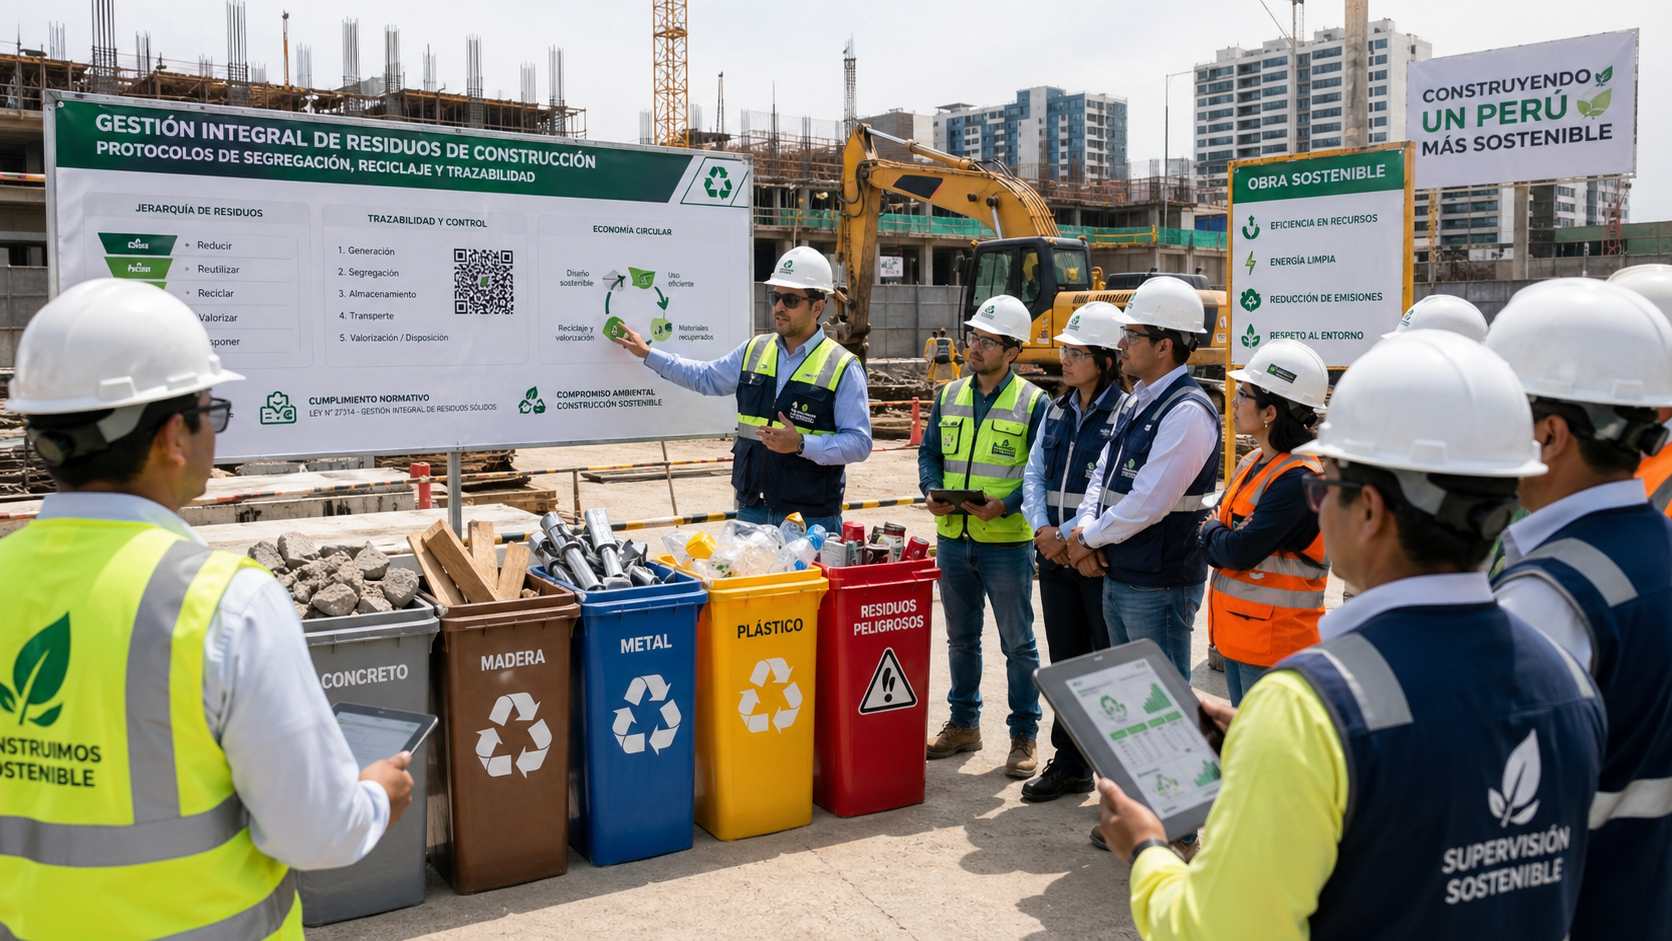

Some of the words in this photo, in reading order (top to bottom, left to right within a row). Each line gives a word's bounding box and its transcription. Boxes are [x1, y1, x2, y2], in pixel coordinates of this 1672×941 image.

[1422, 69, 1591, 103] CONSTRUYENDO
[1422, 107, 1466, 133] UN
[1476, 89, 1567, 127] PERÚ
[95, 113, 195, 138] GESTIÓN
[201, 121, 308, 147] INTEGRAL
[313, 131, 341, 149] DE
[346, 134, 441, 157] RESIDUOS
[446, 143, 469, 160] DE
[473, 145, 596, 169] CONSTRUCCIÓN
[1422, 135, 1467, 156] MÁS
[1473, 123, 1612, 151] SOSTENIBLE
[96, 140, 213, 161] PROTOCOLOS
[218, 149, 240, 163] DE
[243, 151, 355, 172] SEGREGACIÓN,
[358, 159, 432, 177] RECICLAJE
[435, 164, 444, 177] Y
[447, 166, 535, 183] TRAZABILIDAD
[1248, 174, 1288, 190] OBRA
[1291, 164, 1386, 186] SOSTENIBLE
[135, 203, 195, 215] JERARQUÍA
[197, 206, 211, 215] DE
[214, 207, 263, 217] RESIDUOS
[367, 214, 436, 226] TRAZABILIDAD
[437, 217, 444, 226] Y
[445, 218, 488, 228] CONTROL
[1270, 218, 1315, 230] EFICIENCIA
[1317, 218, 1328, 226] EN
[1330, 214, 1378, 225] RECURSOS
[593, 224, 634, 234] ECONOMÍA
[635, 227, 672, 236] CIRCULAR
[197, 241, 232, 251] Reducir
[338, 246, 345, 254] 1.
[348, 246, 395, 256] Generación
[1270, 255, 1305, 266] ENERGÍA
[1307, 255, 1336, 265] LIMPIA
[198, 264, 240, 274] Reutilizar
[338, 267, 346, 276] 2.
[348, 267, 399, 279] Segregación
[198, 289, 234, 298] Reciclar
[339, 290, 346, 298] 3.
[349, 289, 417, 299] Almacenamiento
[1270, 292, 1318, 304] REDUCCIÓN
[1320, 294, 1332, 303] DE
[1334, 292, 1383, 302] EMISIONES
[199, 313, 238, 322] Valorizar
[339, 311, 347, 320] 4.
[350, 311, 394, 321] Transporte
[339, 334, 347, 342] 5.
[350, 333, 398, 342] Valorización
[405, 333, 448, 343] Disposición
[1270, 331, 1306, 340] RESPETO
[1308, 331, 1319, 340] AL
[1321, 331, 1364, 340] ENTORNO
[210, 339, 240, 348] sponer
[309, 395, 378, 405] CUMPLIMIENTO
[379, 394, 430, 403] NORMATIVO
[557, 389, 610, 398] COMPROMISO
[612, 388, 655, 397] AMBIENTAL
[309, 409, 322, 417] LEY
[361, 406, 391, 415] GESTIÓN
[392, 405, 425, 414] INTEGRAL
[426, 405, 435, 413] DE
[557, 400, 617, 410] CONSTRUCCIÓN
[618, 399, 662, 407] SOSTENIBLE
[861, 599, 917, 618] RESIDUOS
[737, 618, 804, 639] PLÁSTICO
[853, 615, 924, 636] PELIGROSOS
[620, 633, 672, 654] METAL
[480, 649, 546, 671] MADERA
[321, 664, 408, 689] CONCRETO
[0, 761, 96, 787] STENIBLE
[1441, 824, 1571, 874] SUPERVISIÓN
[1445, 857, 1563, 904] SOSTENIBLE
